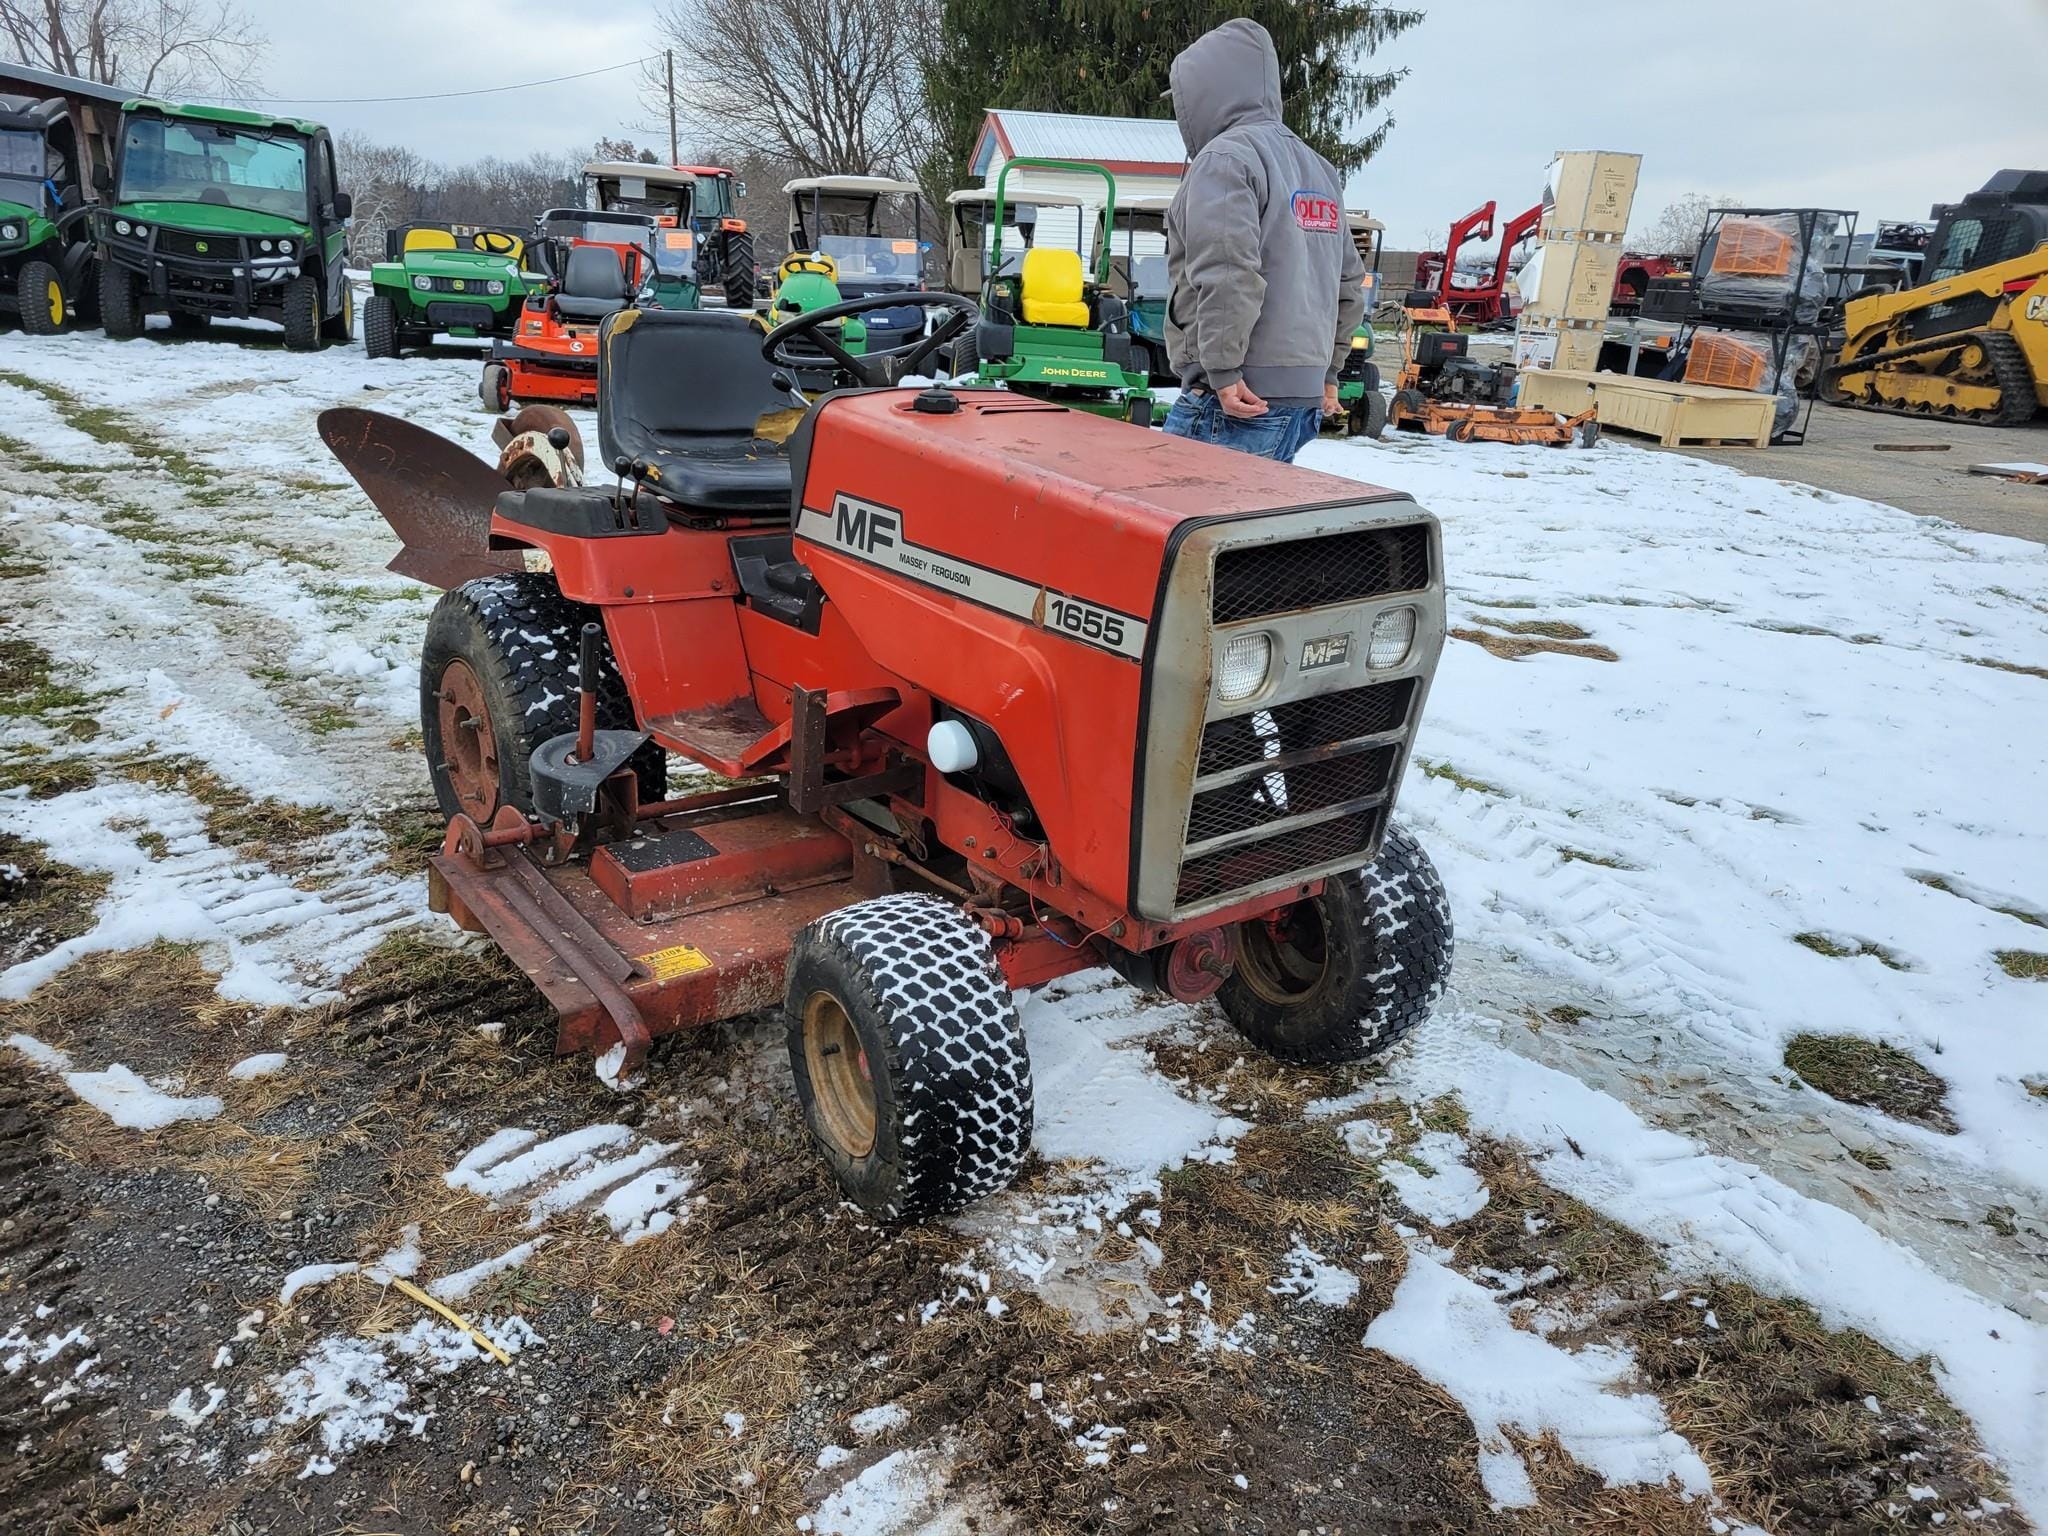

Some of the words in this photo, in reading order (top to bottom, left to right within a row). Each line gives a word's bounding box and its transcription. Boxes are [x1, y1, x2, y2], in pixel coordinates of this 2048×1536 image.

[1041, 367, 1070, 376] JOHN
[1071, 368, 1107, 378] DEERE
[836, 502, 897, 554] MF
[899, 553, 928, 571] MASSEY
[931, 564, 971, 587] FERGUSON
[1051, 599, 1125, 646] 1655
[1302, 638, 1348, 667] MF
